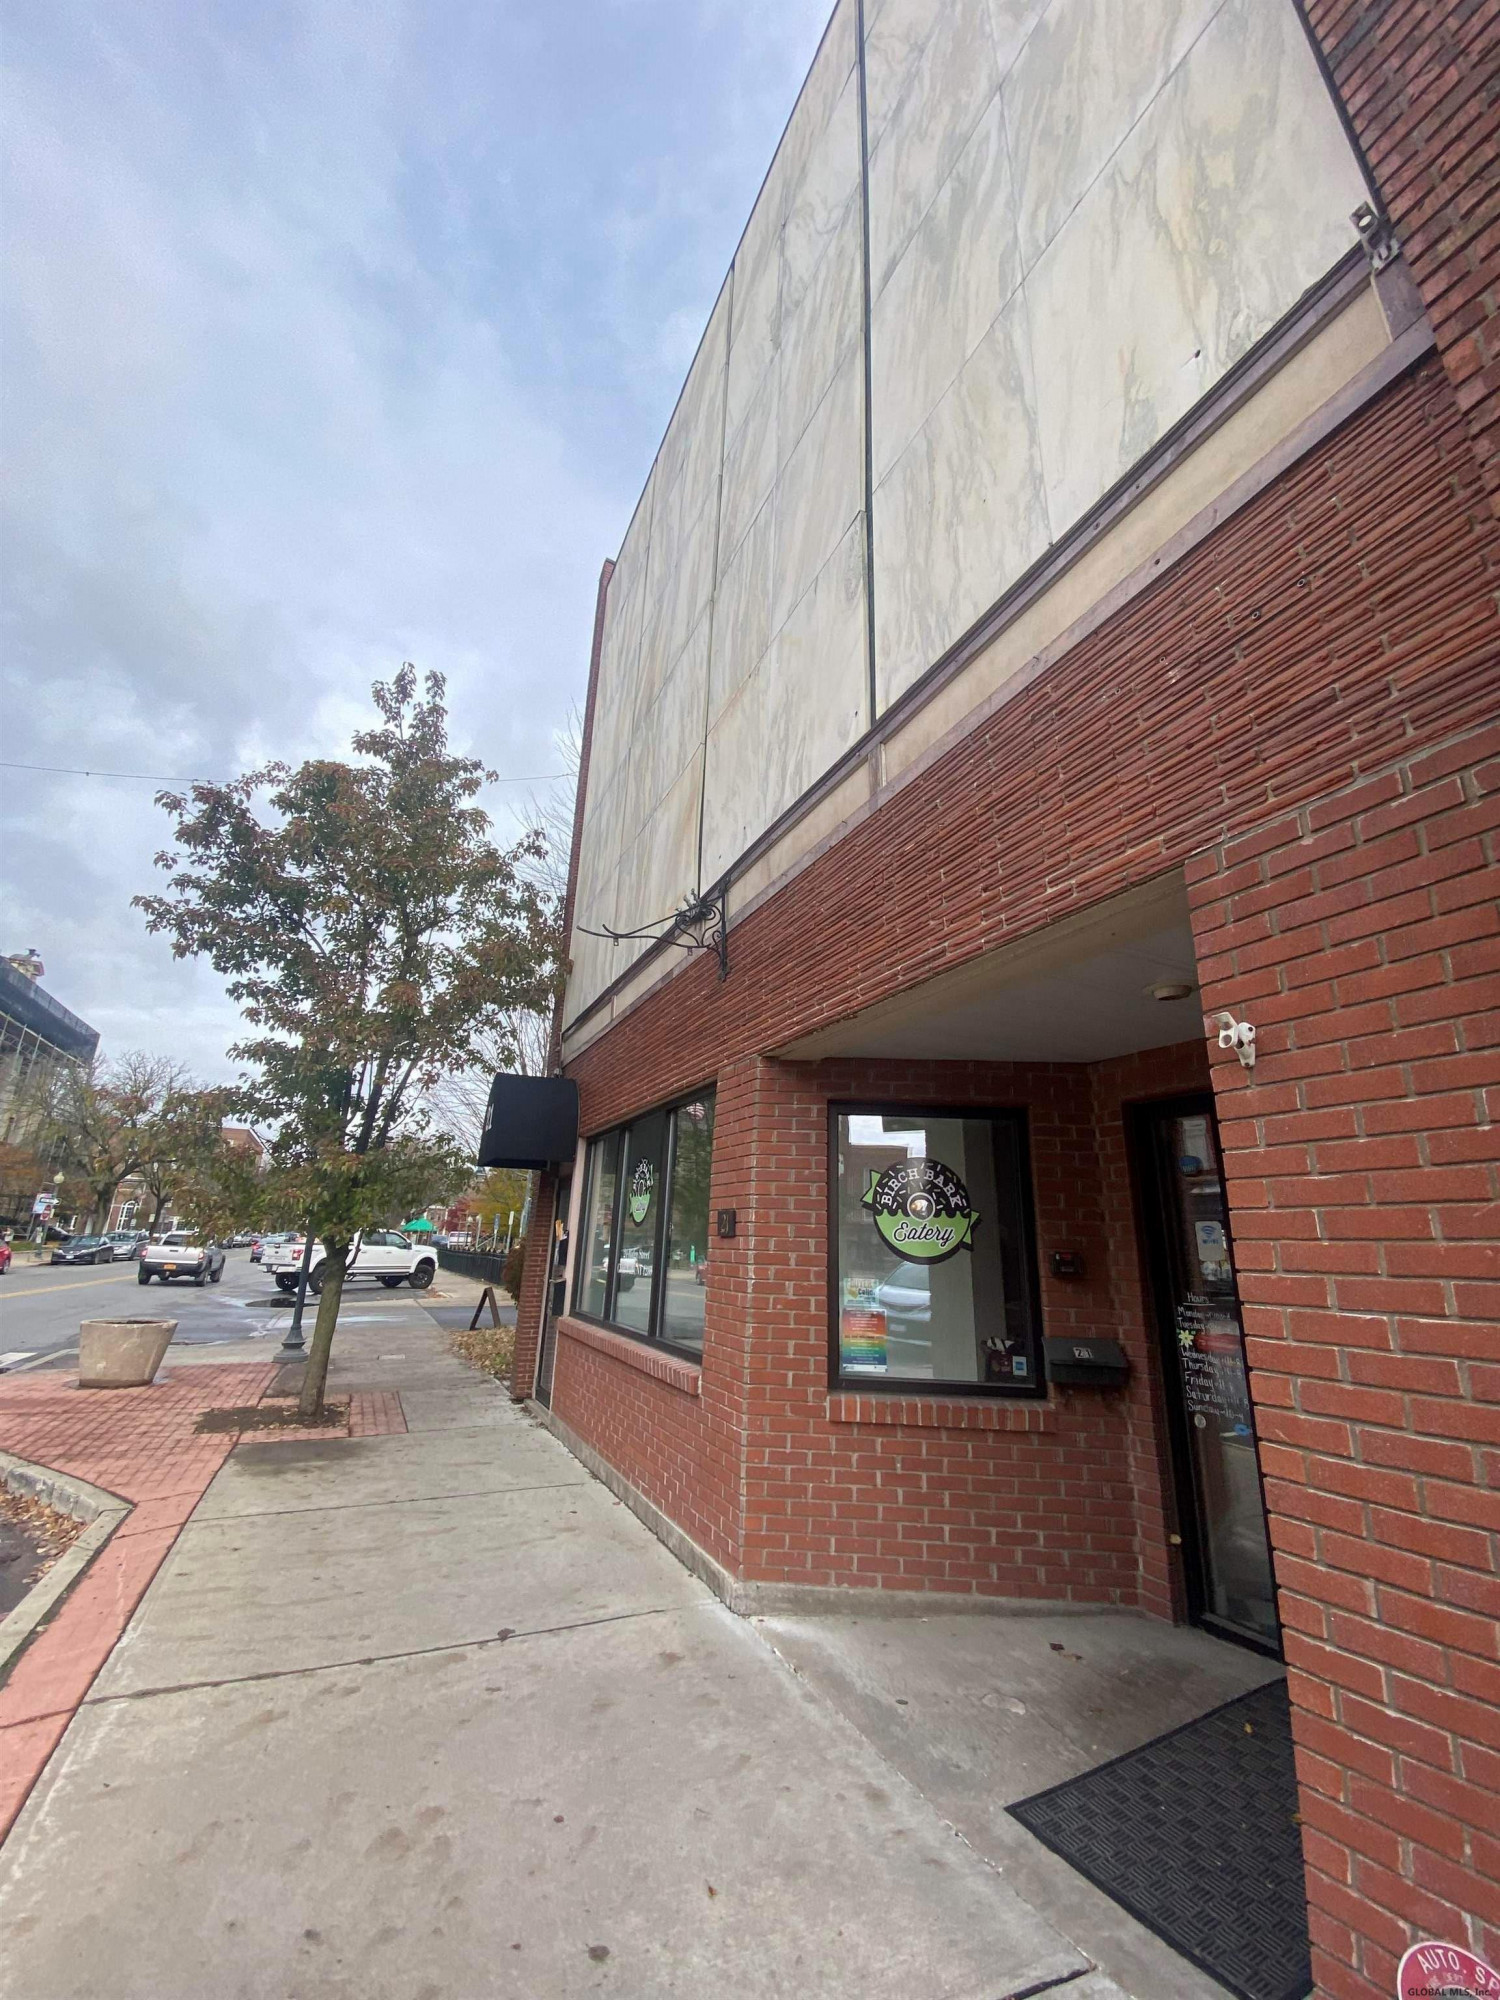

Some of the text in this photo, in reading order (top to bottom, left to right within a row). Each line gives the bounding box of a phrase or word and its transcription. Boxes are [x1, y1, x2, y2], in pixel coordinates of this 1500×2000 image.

[881, 1168, 963, 1208] BIRCH BARK
[893, 1221, 955, 1248] Eatery
[1187, 1292, 1210, 1304] Hours
[1185, 1371, 1215, 1391] Friday
